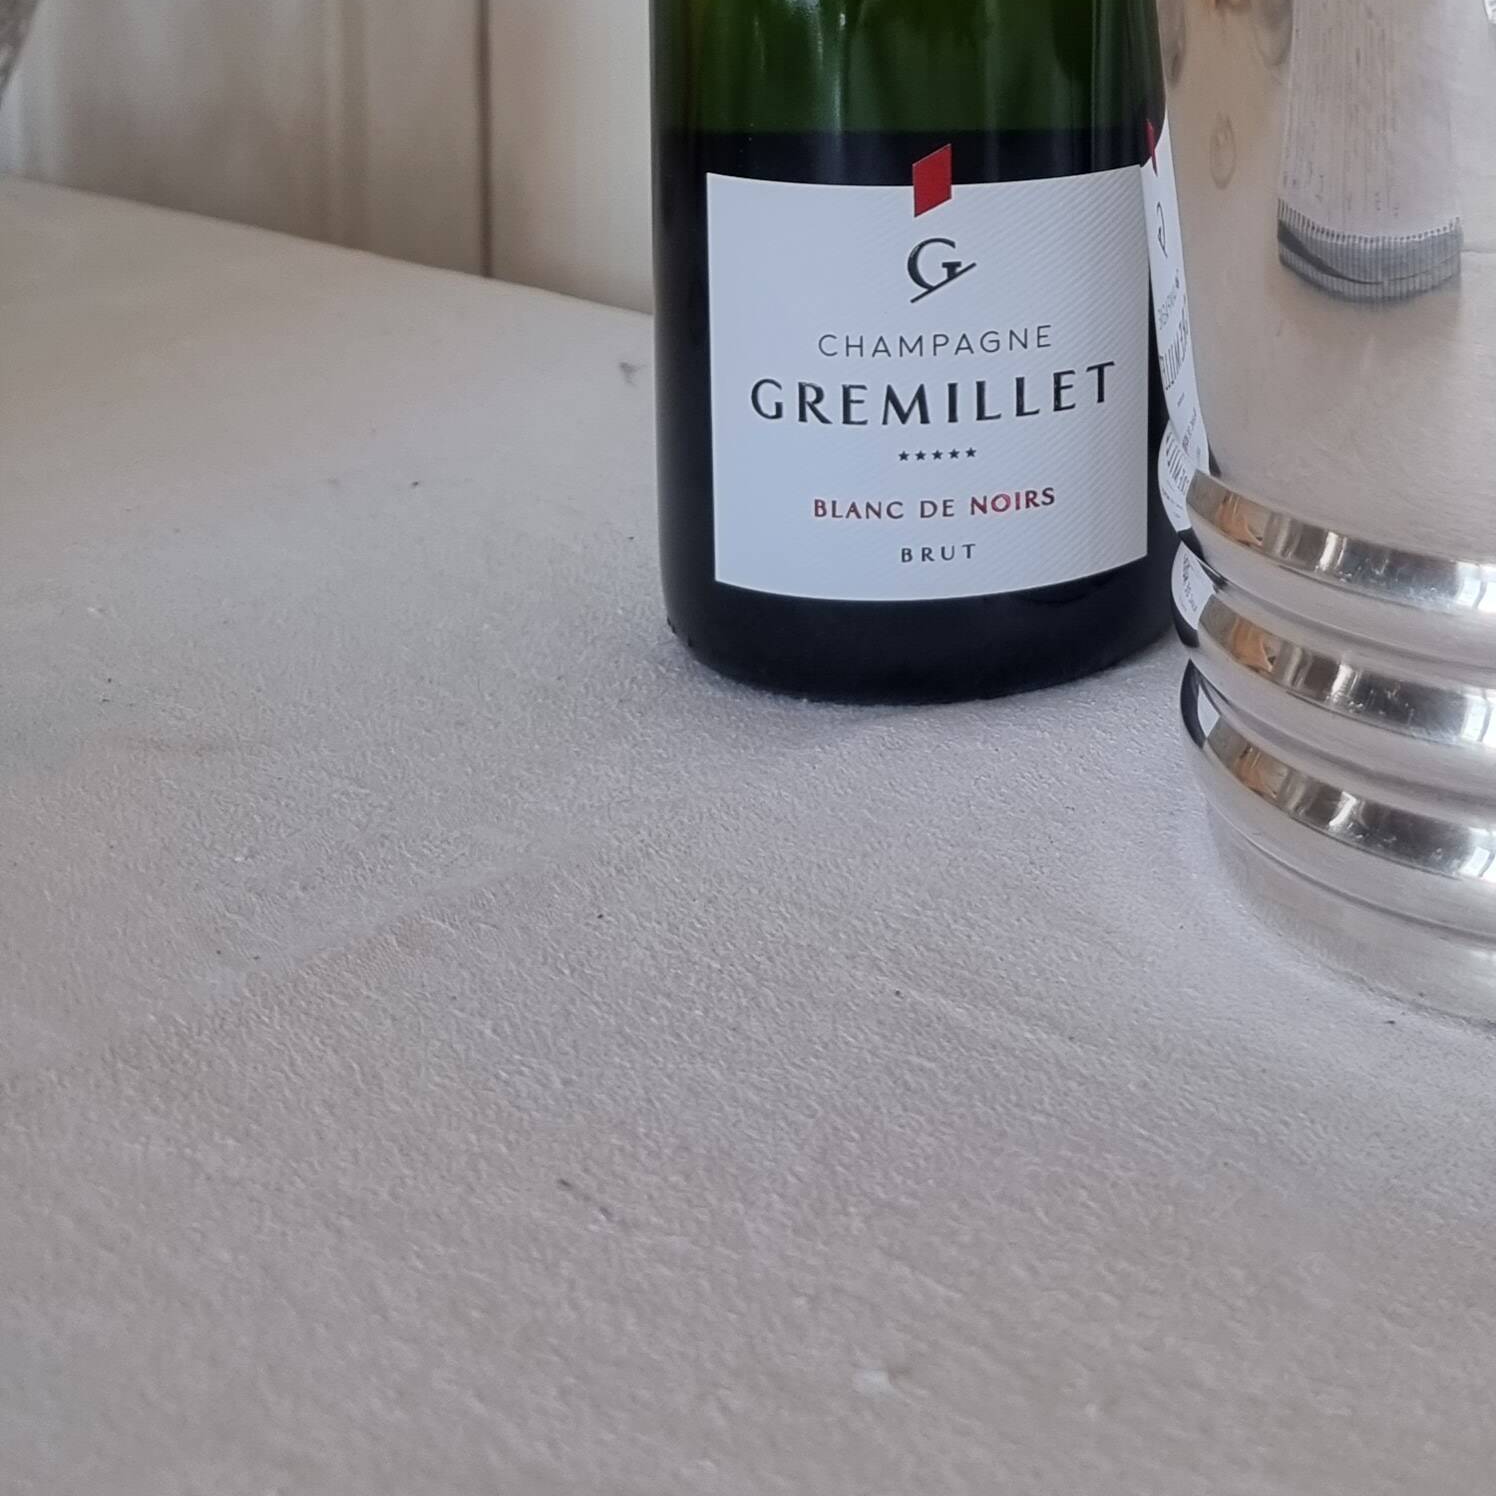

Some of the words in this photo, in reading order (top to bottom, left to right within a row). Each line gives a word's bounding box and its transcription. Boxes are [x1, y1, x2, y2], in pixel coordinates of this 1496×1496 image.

[907, 237, 977, 304] G
[818, 325, 1052, 358] CHAMPAGNE
[750, 361, 1116, 426] GREMILLET
[813, 498, 905, 520] BLANC
[919, 498, 955, 519] DE
[970, 487, 1056, 516] NOIRS
[901, 543, 976, 564] BRUT
